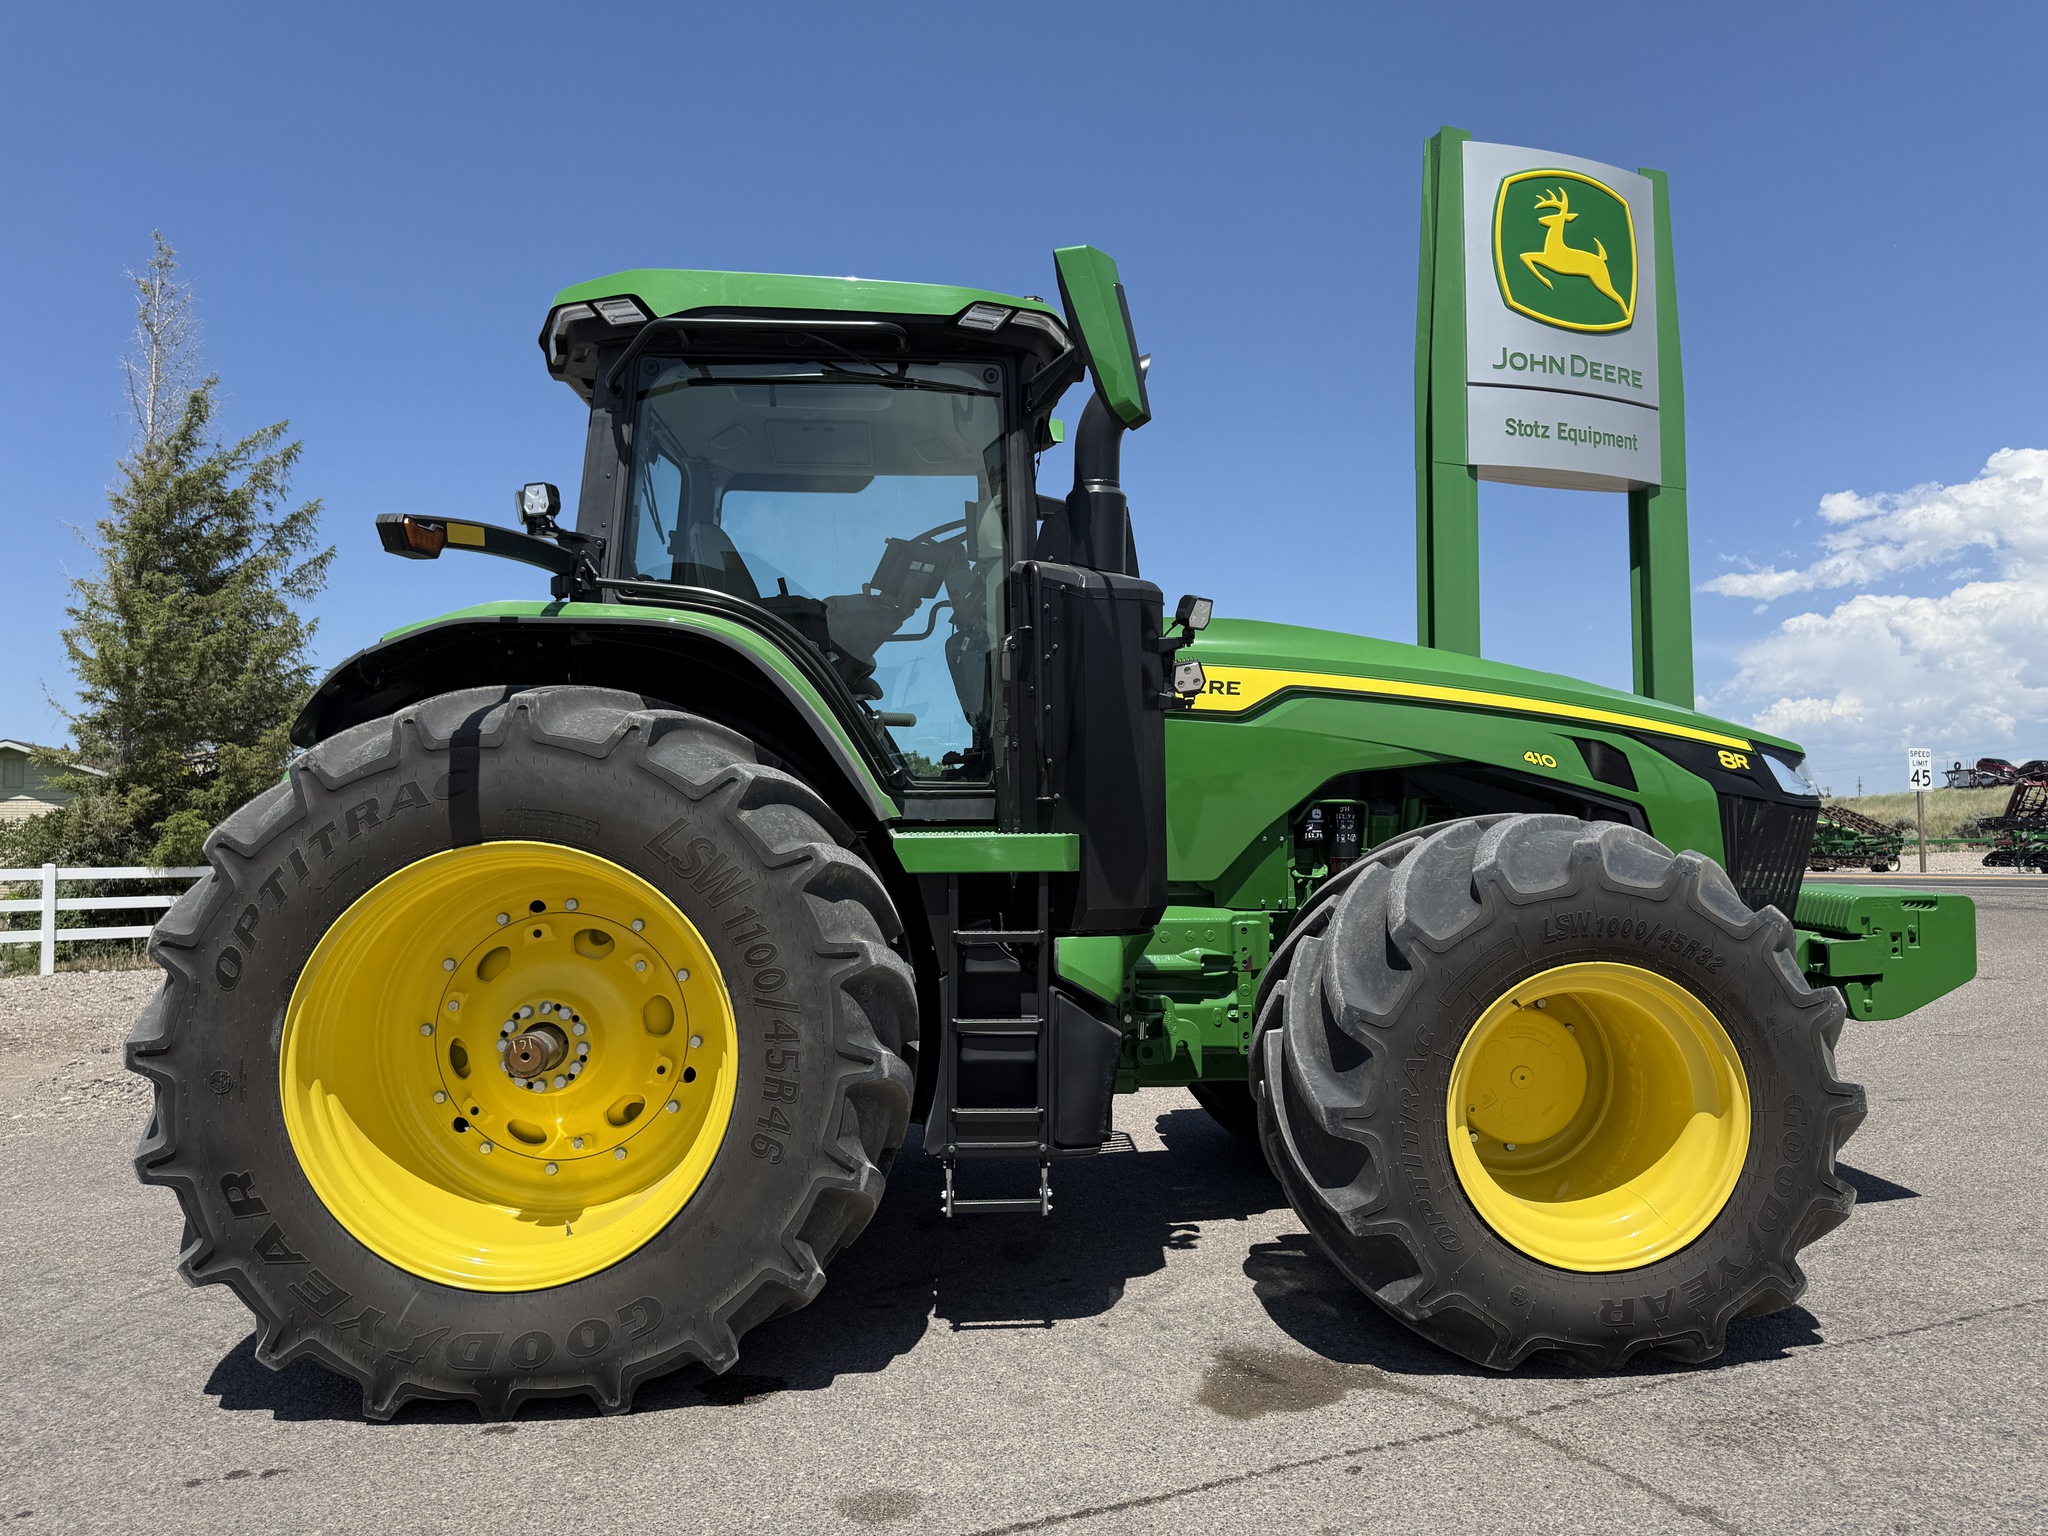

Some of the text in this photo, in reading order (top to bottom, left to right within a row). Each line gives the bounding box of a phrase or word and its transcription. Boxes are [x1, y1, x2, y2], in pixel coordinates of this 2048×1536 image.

[1492, 347, 1643, 389] JOHN DEERE
[1505, 418, 1638, 451] Stotz Equipment
[1523, 750, 1557, 769] 410
[1717, 750, 1750, 770] 8R
[1909, 750, 1931, 758] SPEED
[1911, 769, 1931, 787] 45
[215, 769, 470, 991] OPTITRAC
[1543, 910, 1726, 974] LSW 1000/45R32
[643, 817, 802, 1165] LSW 1100/45R46
[1399, 1024, 1464, 1252] OPTITRAC
